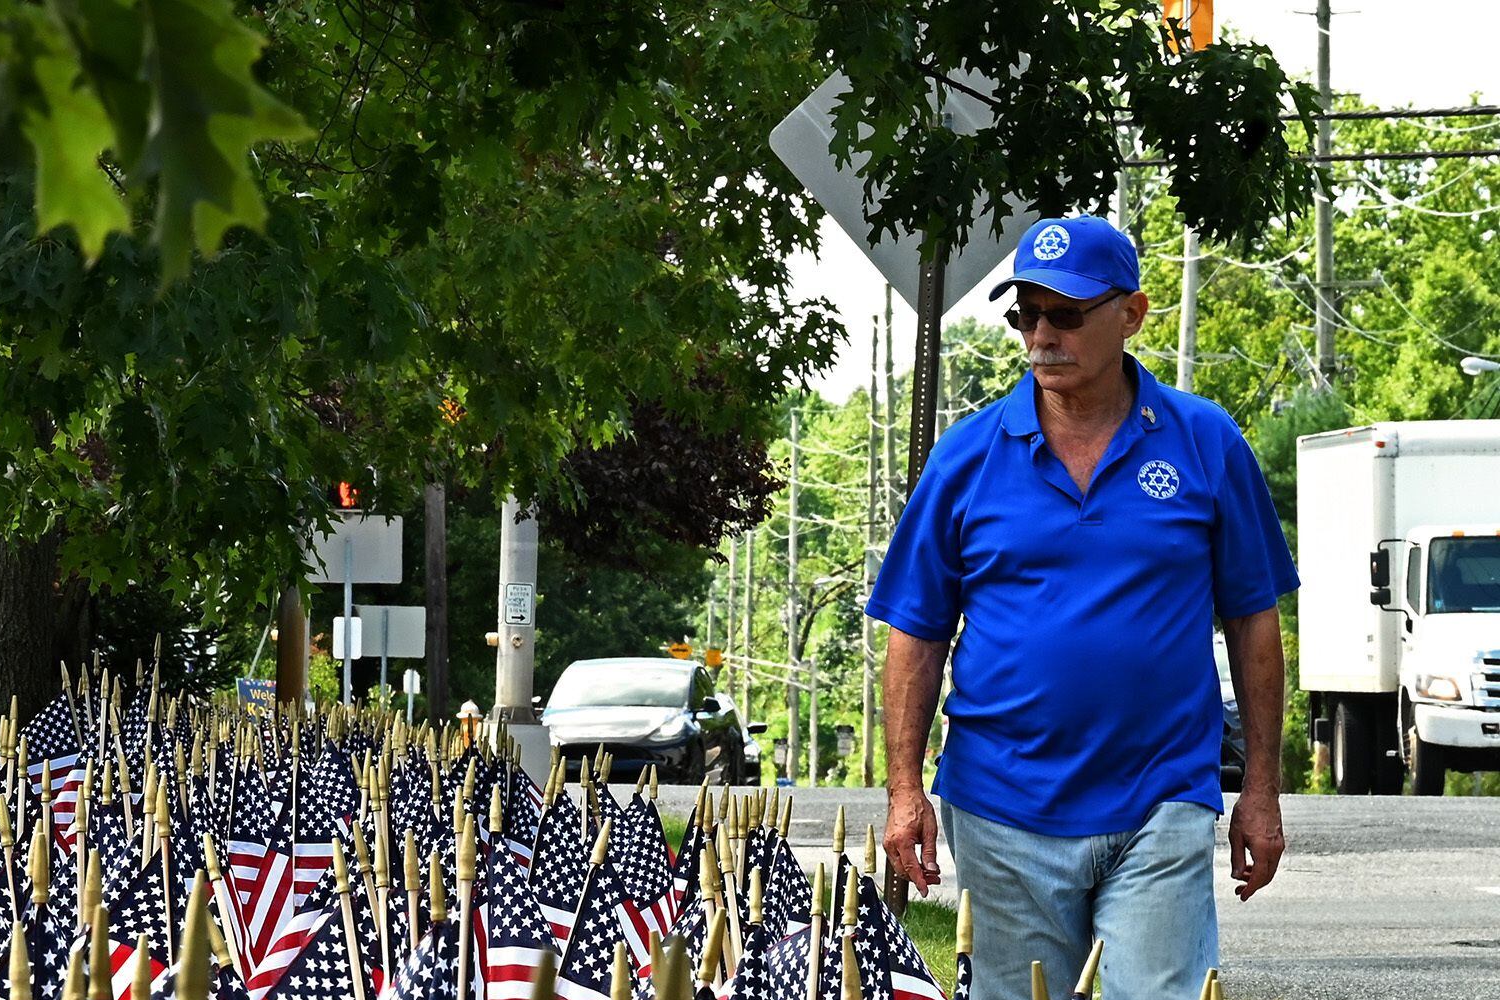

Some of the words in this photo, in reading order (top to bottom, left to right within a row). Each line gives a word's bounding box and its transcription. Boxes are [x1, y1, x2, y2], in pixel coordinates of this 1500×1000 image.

[1139, 462, 1157, 478] SOUTH
[1157, 462, 1179, 480] JERSEY
[1161, 484, 1176, 498] CLUB
[250, 689, 276, 701] Welc
